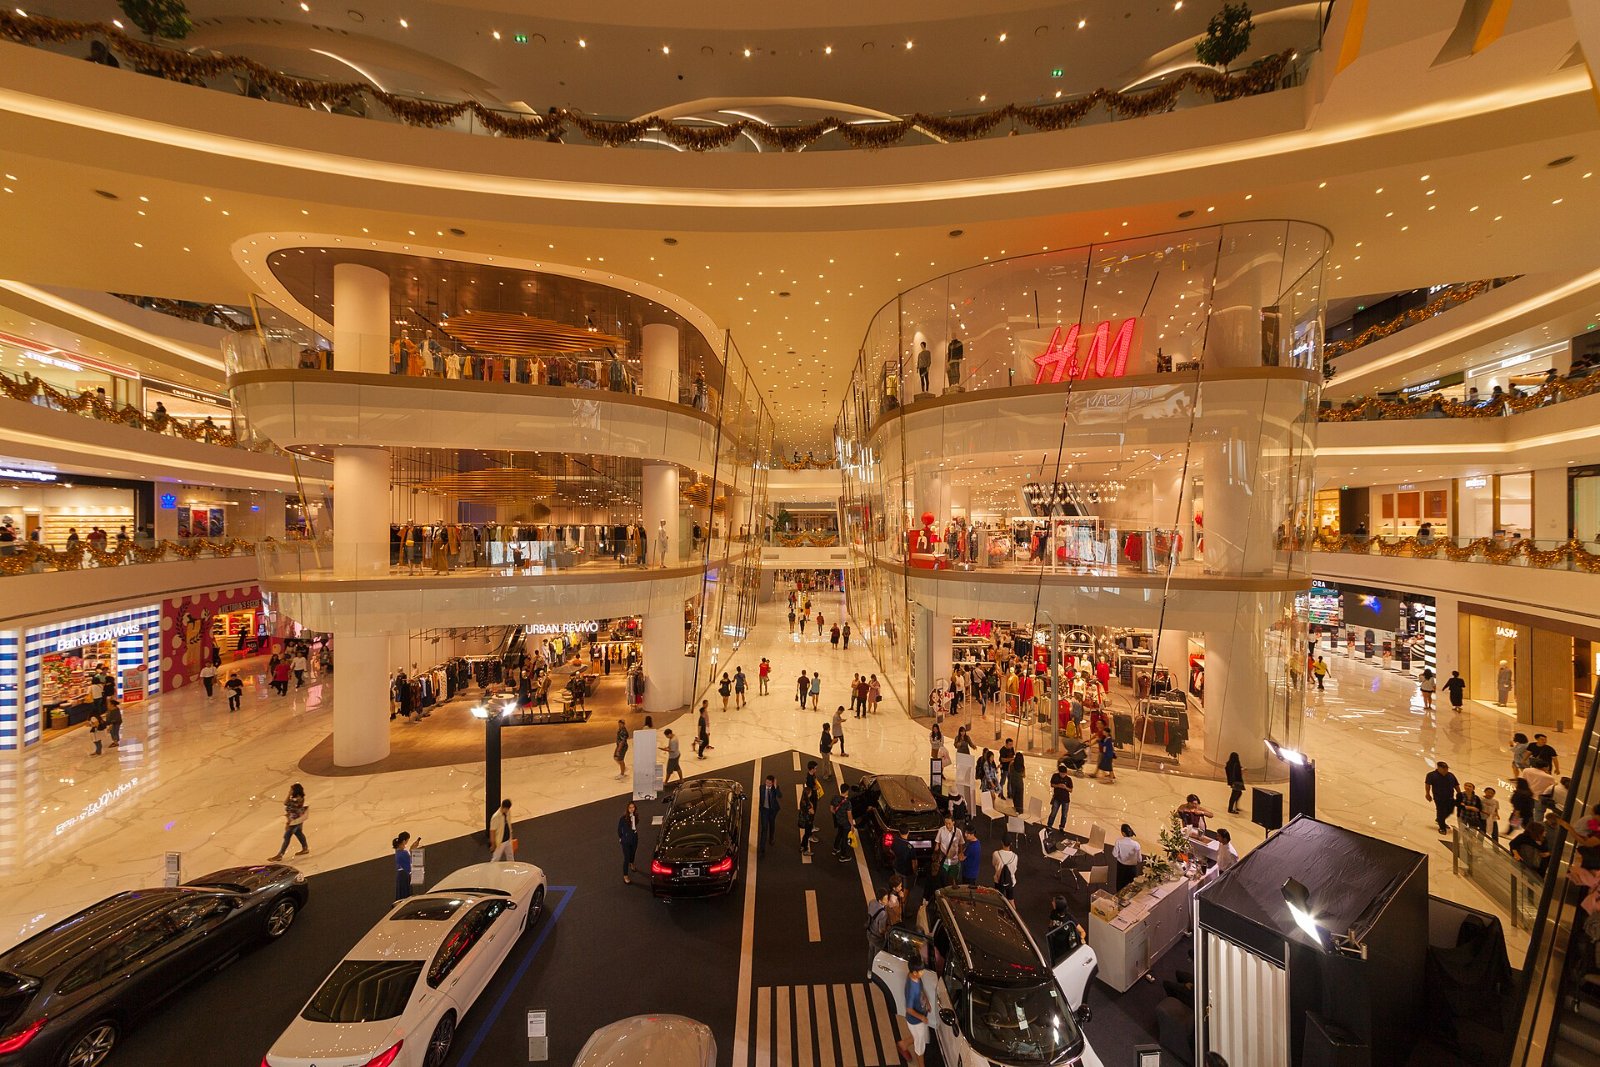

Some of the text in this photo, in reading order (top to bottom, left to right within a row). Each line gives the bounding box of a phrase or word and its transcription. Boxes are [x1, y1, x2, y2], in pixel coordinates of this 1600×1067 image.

[1034, 317, 1136, 385] H&M
[57, 624, 140, 651] Bath & Body Works
[525, 622, 599, 634] URBAN REVIVO
